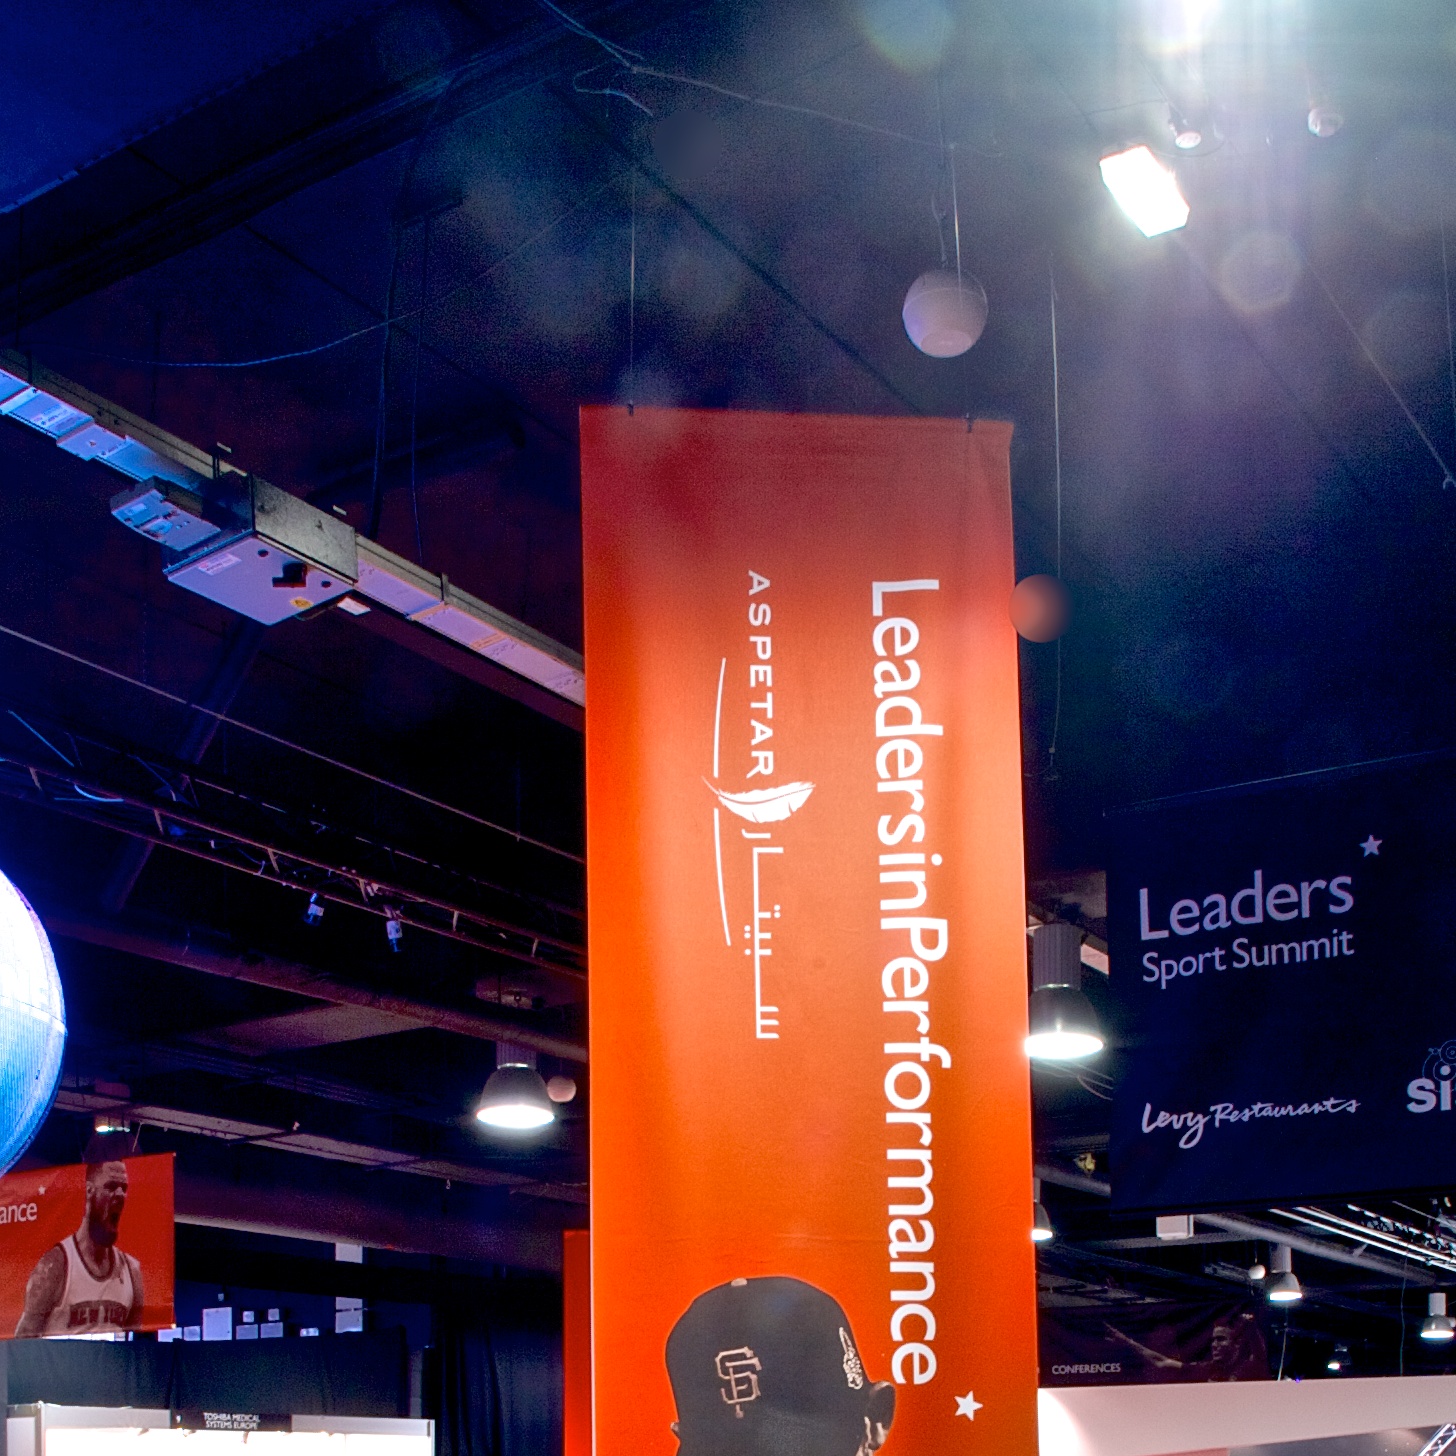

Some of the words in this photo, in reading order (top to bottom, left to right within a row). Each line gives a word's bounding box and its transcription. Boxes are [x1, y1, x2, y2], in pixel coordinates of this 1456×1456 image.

[746, 570, 775, 777] ASPETAR
[1139, 869, 1355, 940] Leaders
[1142, 947, 1227, 990] Sport
[1232, 929, 1355, 969] Summit
[1141, 1103, 1212, 1149] Levy
[1209, 1097, 1362, 1128] Restaurants
[1051, 1363, 1121, 1375] CONFERENCES
[203, 1412, 231, 1421] TOSHIBA
[232, 1413, 260, 1422] MEDICAL
[206, 1421, 232, 1429] SYSTEMS
[233, 1422, 258, 1430] EUROPE
